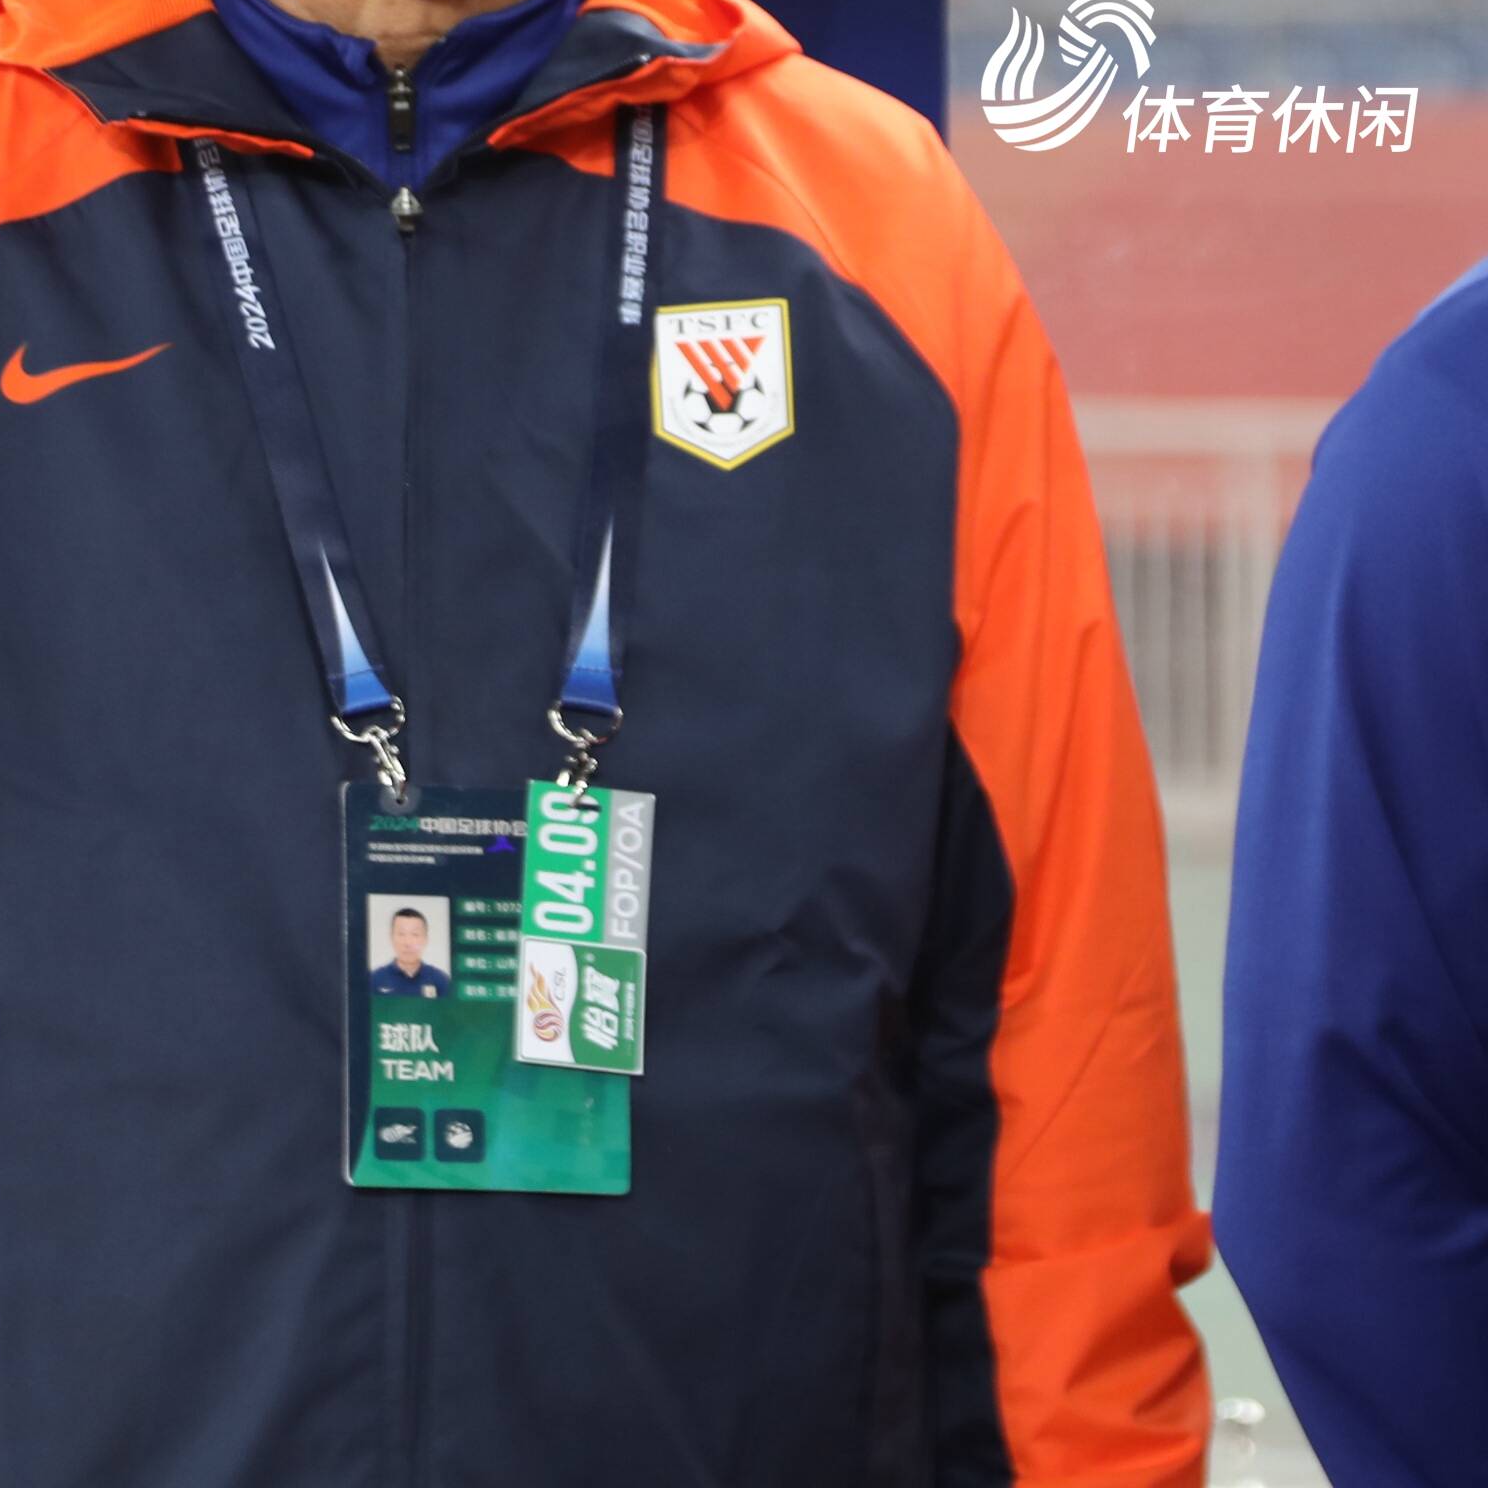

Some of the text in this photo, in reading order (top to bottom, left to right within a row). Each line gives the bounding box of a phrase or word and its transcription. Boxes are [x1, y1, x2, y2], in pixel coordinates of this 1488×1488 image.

[670, 311, 769, 335] TSFC
[532, 789, 601, 936] 04.09
[612, 800, 645, 940] FOP/OA
[379, 1022, 439, 1054] 球队
[380, 1059, 454, 1082] TEAM
